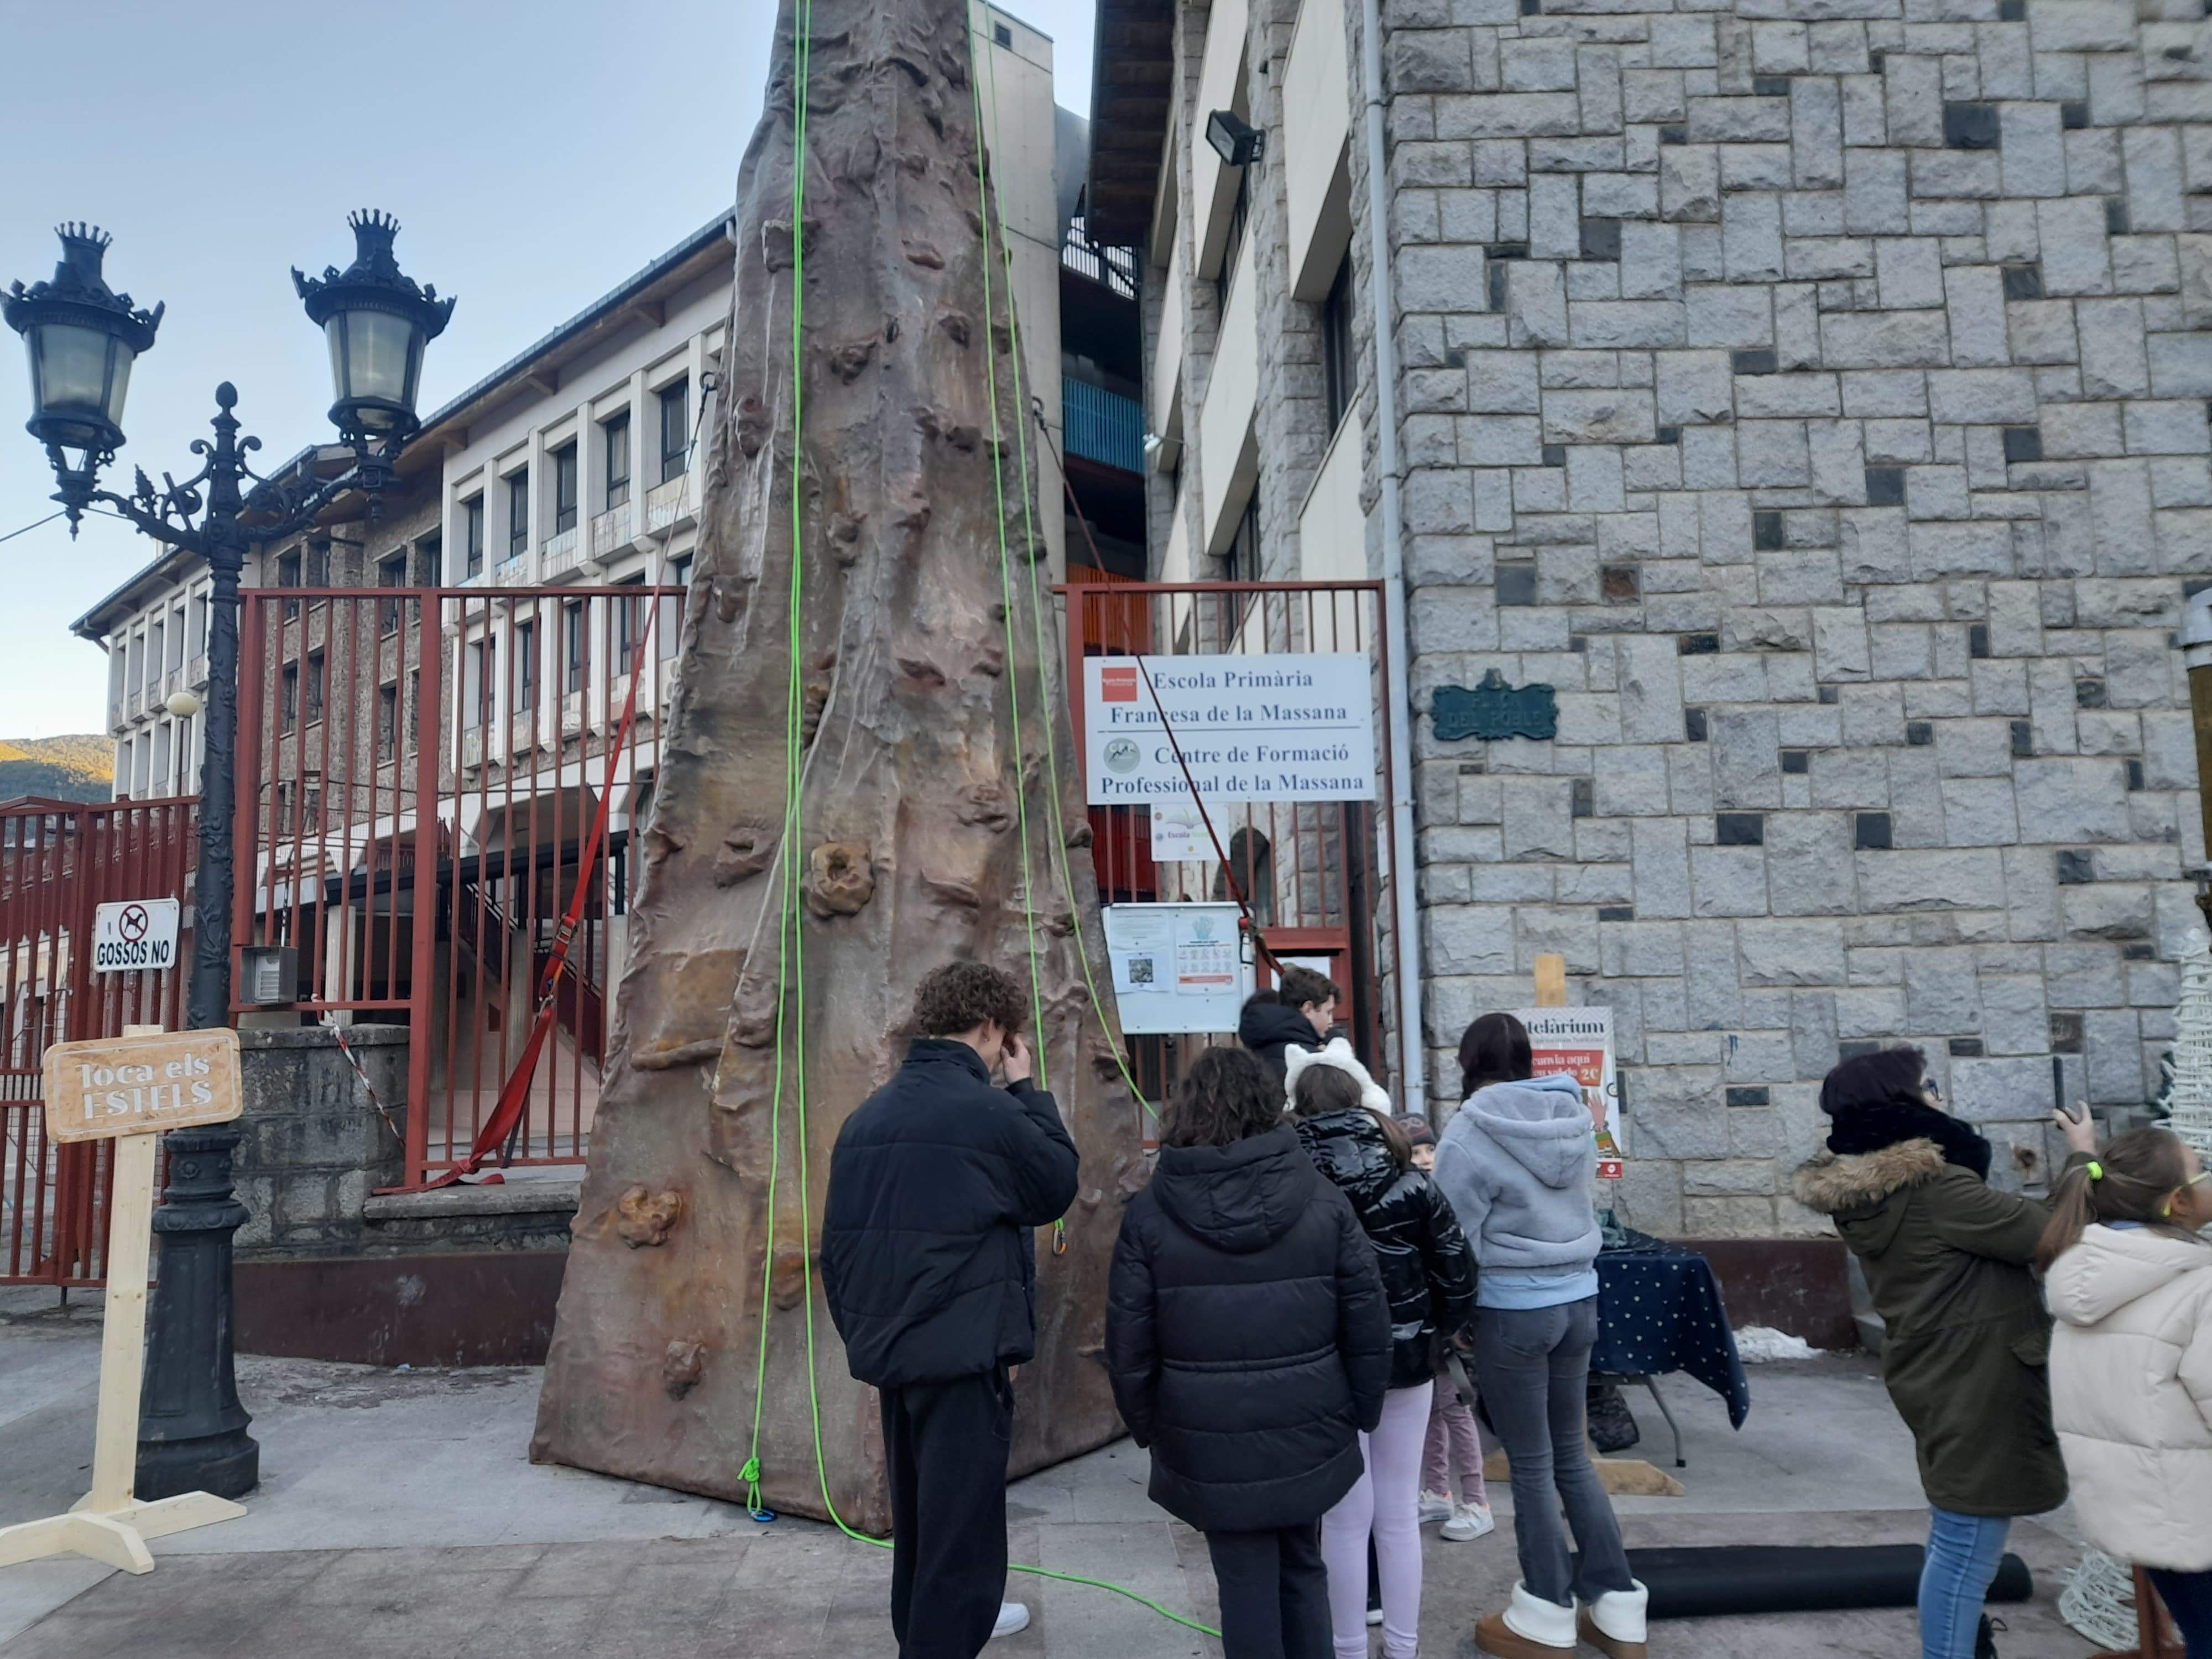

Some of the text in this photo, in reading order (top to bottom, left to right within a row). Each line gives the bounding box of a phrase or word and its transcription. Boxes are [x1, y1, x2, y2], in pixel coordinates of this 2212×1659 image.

[1154, 672, 1216, 689] Escola
[1224, 670, 1313, 688] Primària
[1111, 703, 1347, 723] Francesa de la Massana
[1155, 743, 1349, 764] Centre de Formació
[1102, 773, 1364, 794] Professional de la Massana
[97, 940, 169, 965] GOSSOS NO
[75, 1053, 210, 1089] Toca els
[82, 1081, 213, 1120] ESTELS
